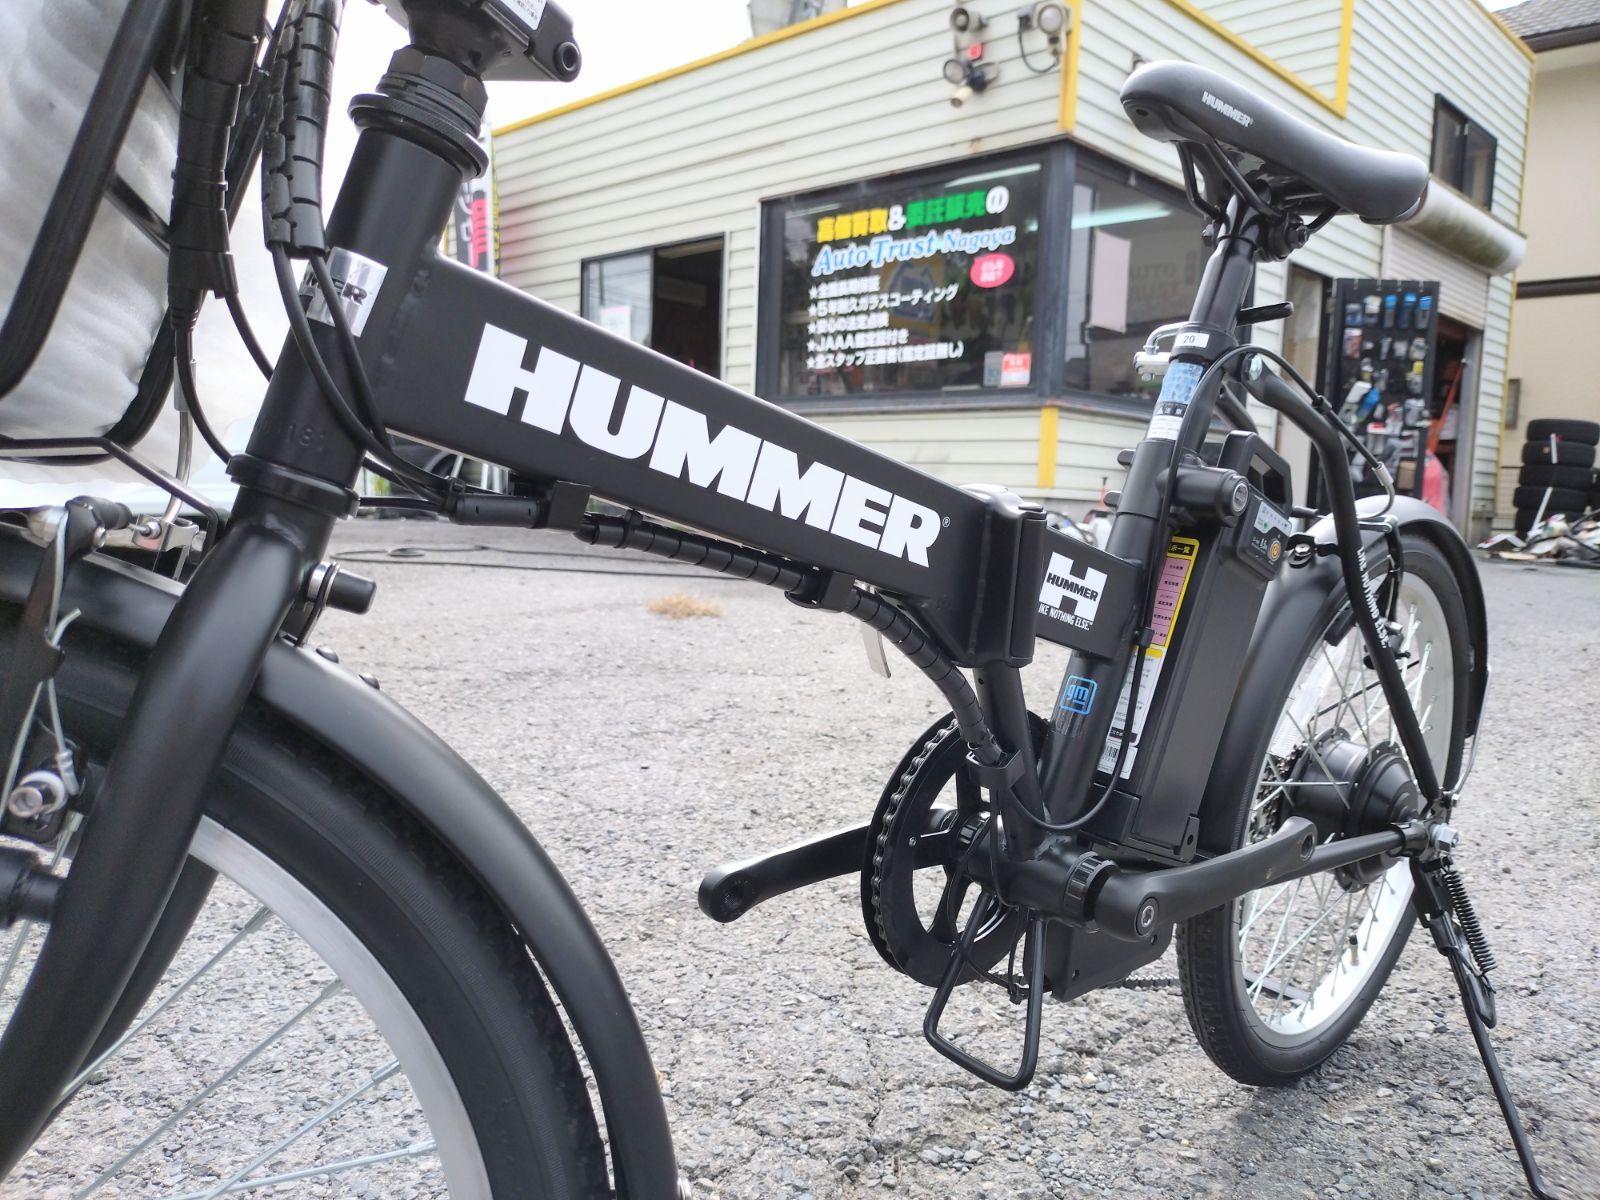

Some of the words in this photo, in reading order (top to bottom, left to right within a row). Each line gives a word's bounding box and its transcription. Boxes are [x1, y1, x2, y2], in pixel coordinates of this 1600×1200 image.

[1202, 90, 1251, 127] HUMMER
[942, 225, 1016, 254] Nagoya
[1183, 335, 1196, 344] 20
[464, 322, 941, 569] HUMMER
[1046, 572, 1099, 602] HUMMER
[1049, 607, 1076, 625] NOTHING
